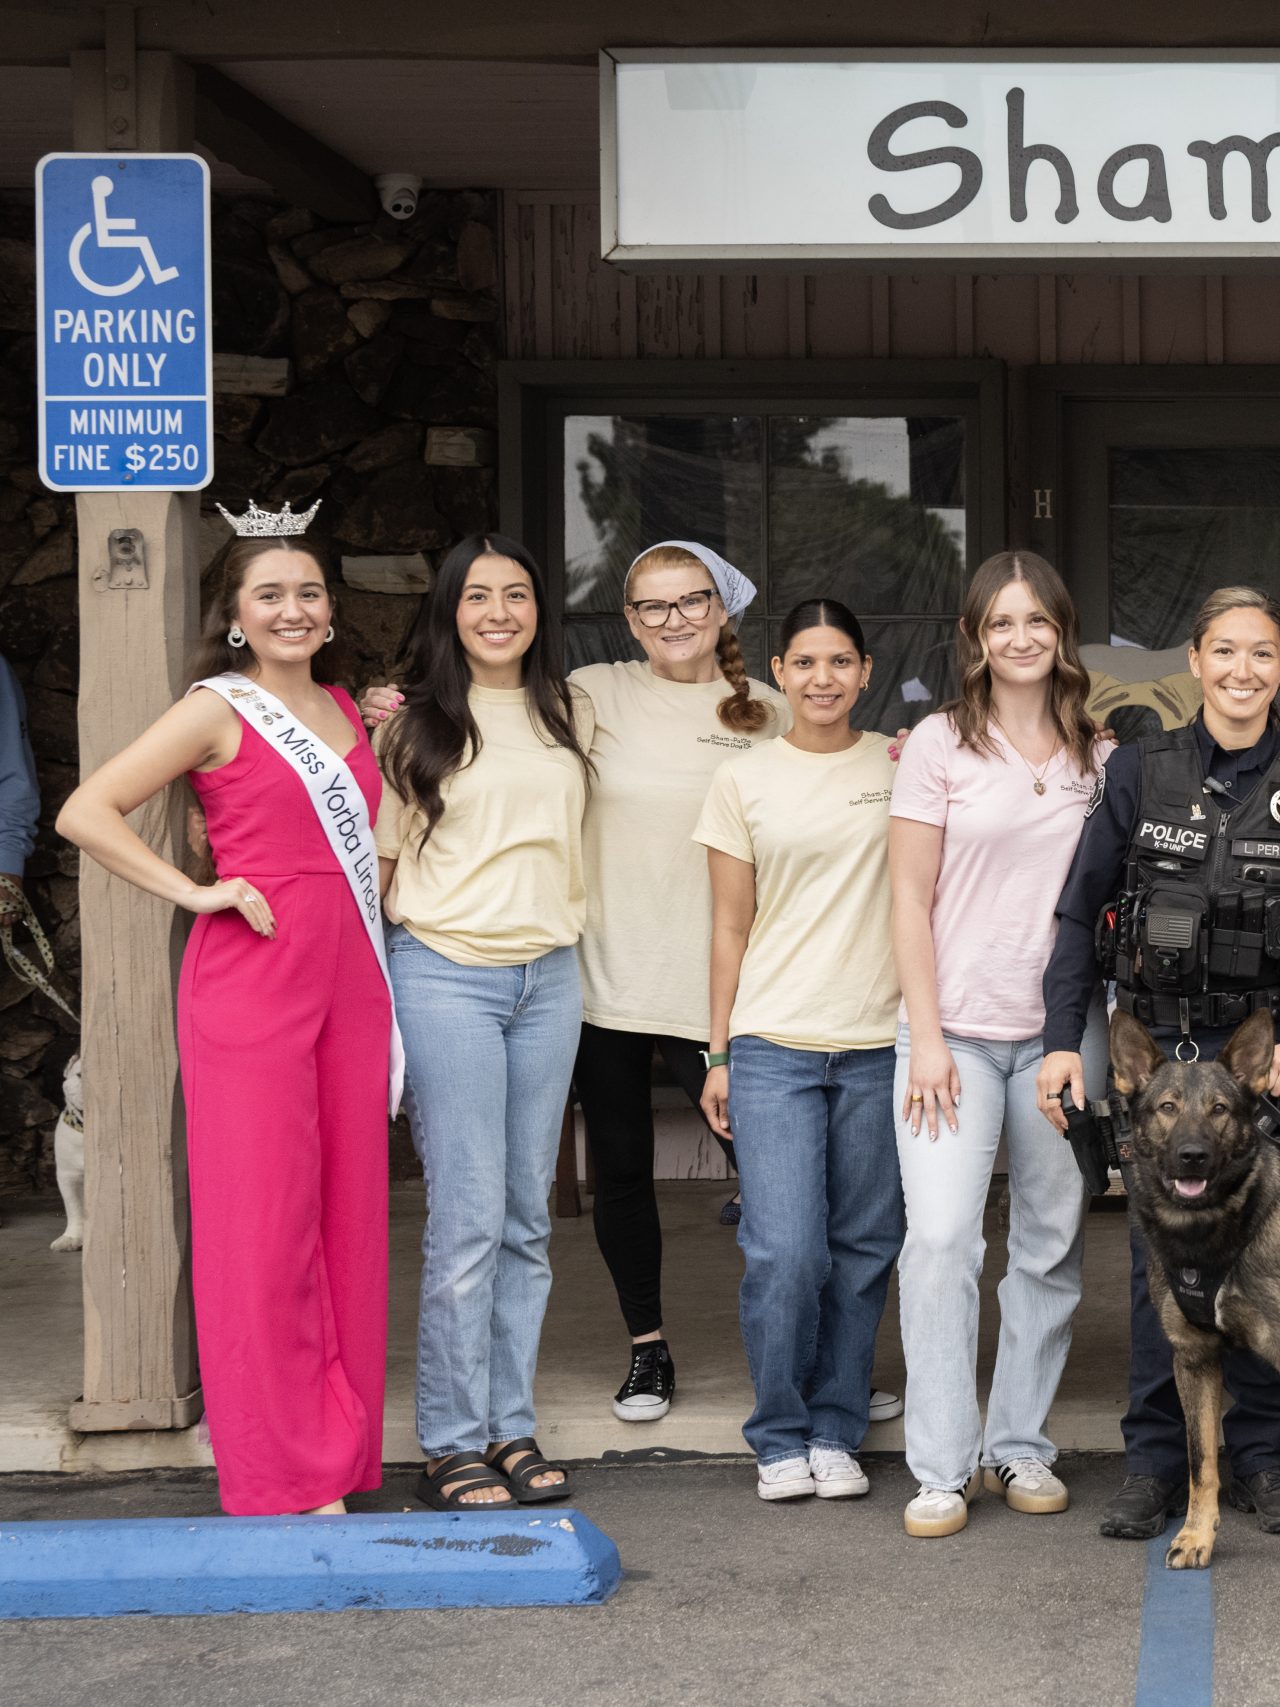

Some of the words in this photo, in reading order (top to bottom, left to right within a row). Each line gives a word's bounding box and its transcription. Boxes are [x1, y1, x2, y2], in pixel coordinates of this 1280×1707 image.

[53, 309, 196, 344] PARKING
[83, 352, 167, 388] ONLY
[70, 408, 183, 435] MINIMUM
[53, 445, 110, 471] FINE
[125, 442, 199, 474] $250
[1034, 489, 1053, 518] H
[711, 739, 729, 748] Serve
[276, 727, 325, 776] Miss
[321, 773, 361, 855] Yorba
[354, 852, 378, 924] Linda
[1140, 822, 1207, 849] POLICE
[1154, 840, 1169, 849] K-9
[1169, 843, 1186, 853] UNIT
[1244, 842, 1254, 854] L.
